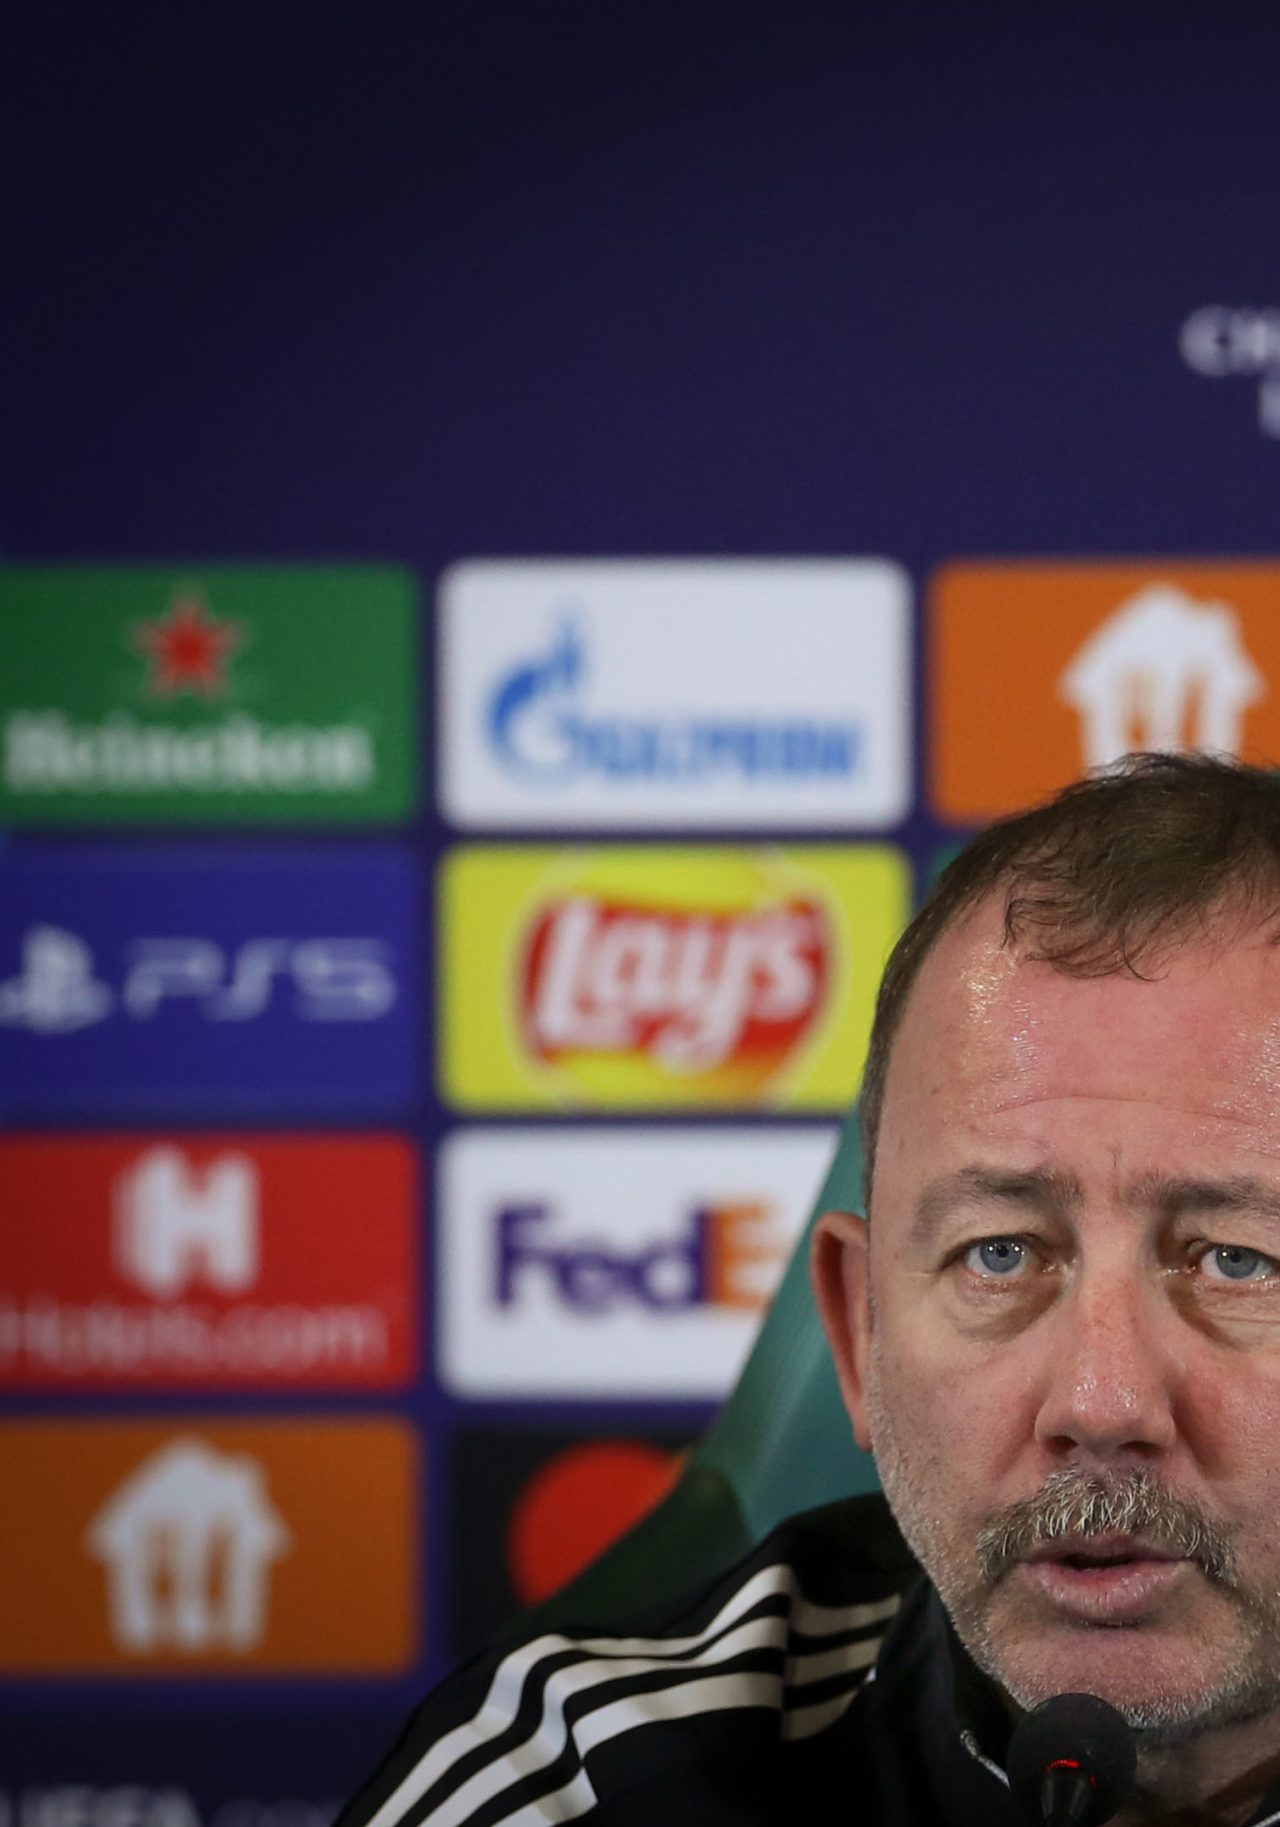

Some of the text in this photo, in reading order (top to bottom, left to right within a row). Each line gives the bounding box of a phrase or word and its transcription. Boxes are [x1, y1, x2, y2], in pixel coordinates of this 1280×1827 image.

[4, 710, 374, 790] Heineken
[126, 937, 396, 1021] PS5
[492, 1200, 786, 1312] FedE
